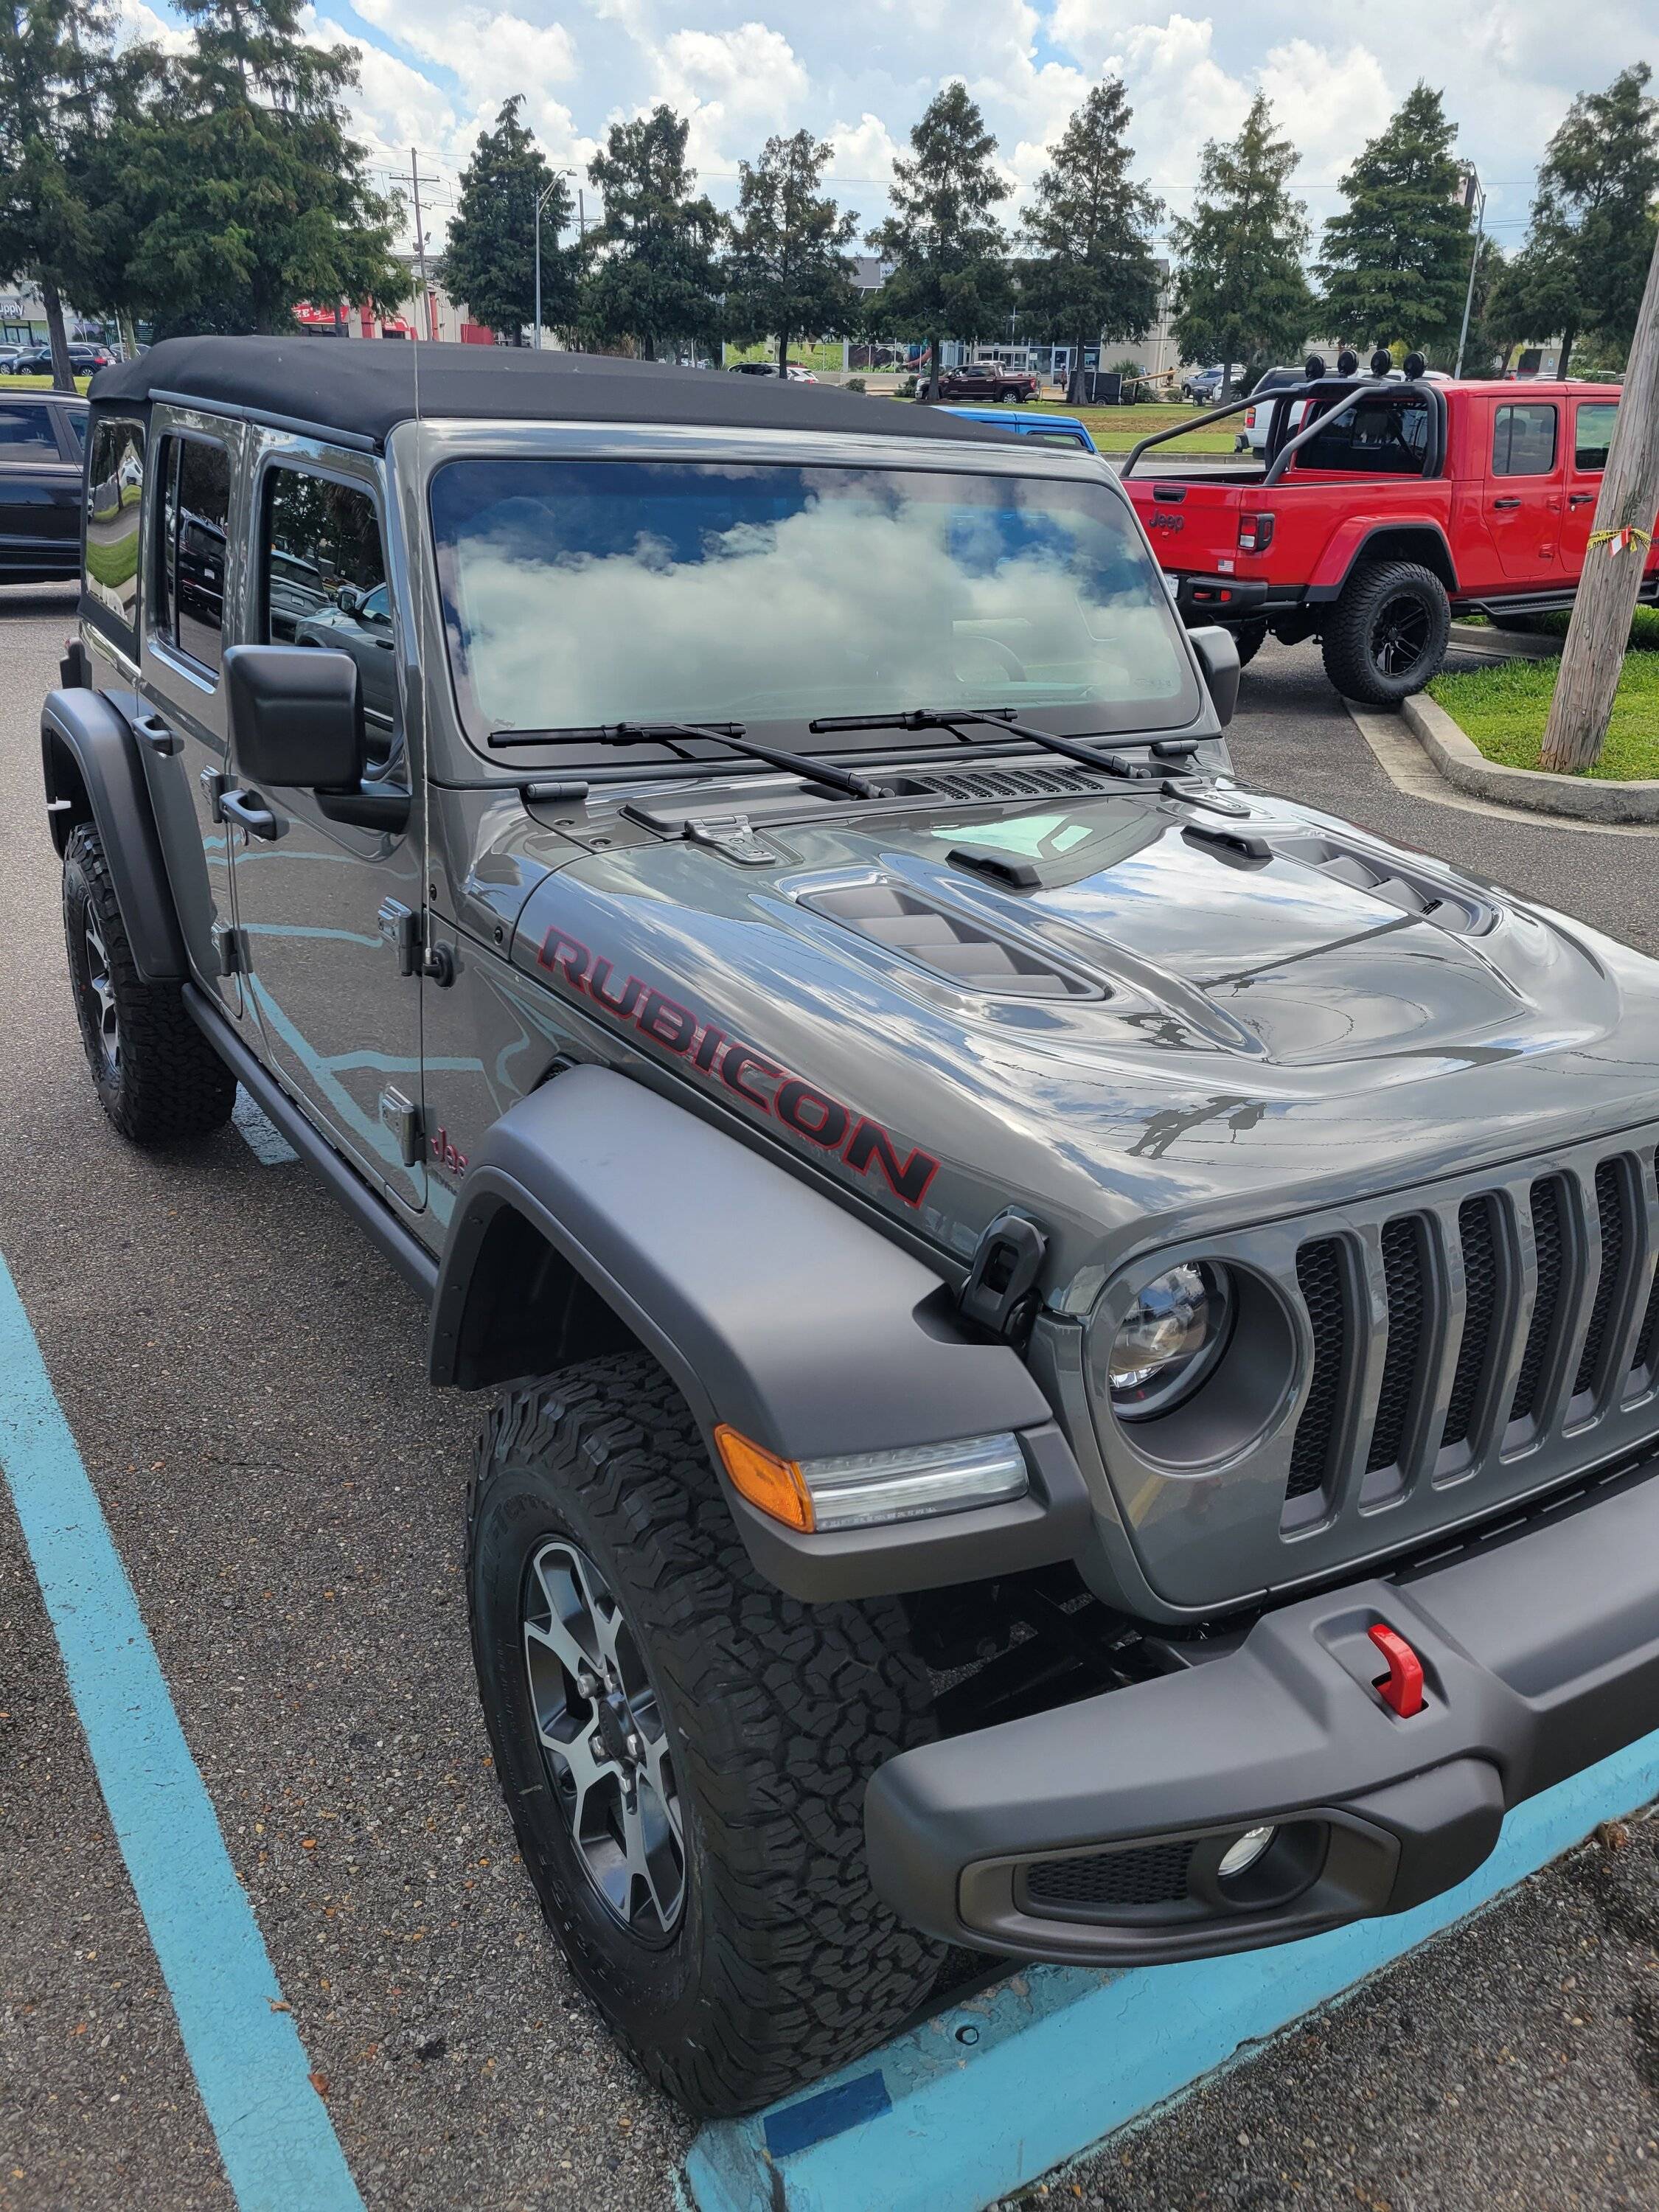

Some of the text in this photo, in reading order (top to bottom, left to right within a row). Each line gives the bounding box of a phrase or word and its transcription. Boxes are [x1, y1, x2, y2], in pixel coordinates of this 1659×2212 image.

[1150, 508, 1184, 534] Jeep
[538, 925, 942, 1209] RUBICON
[431, 1125, 470, 1180] Jee
